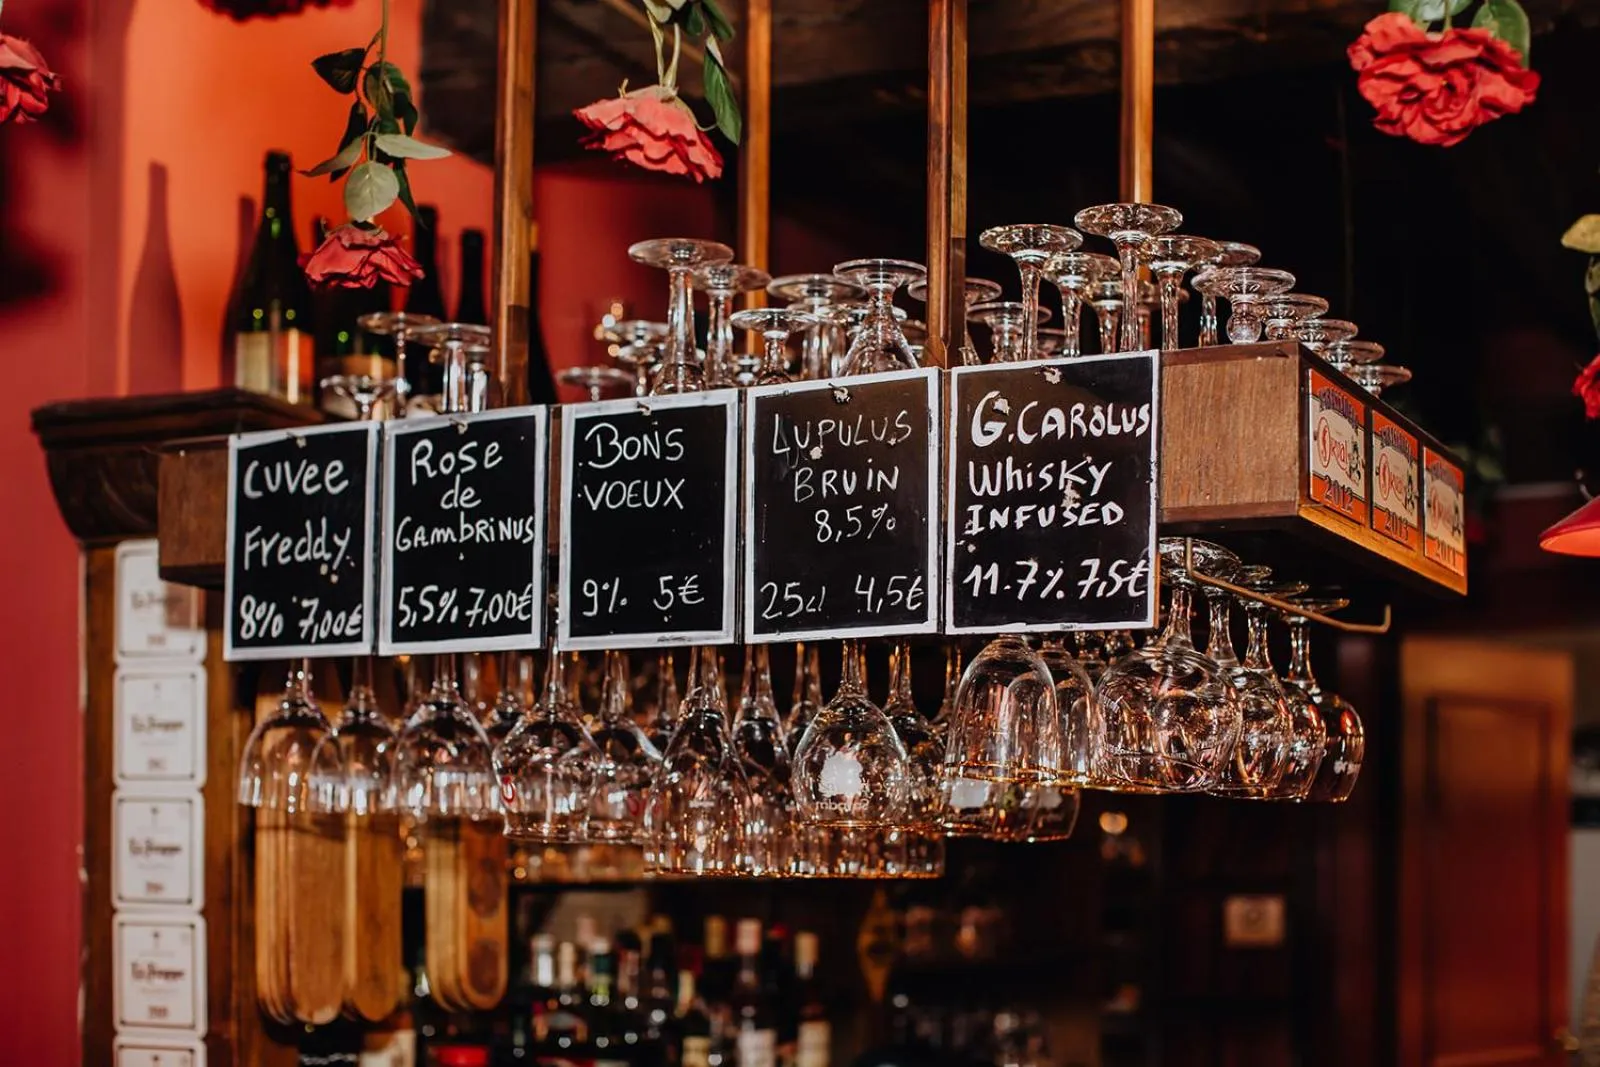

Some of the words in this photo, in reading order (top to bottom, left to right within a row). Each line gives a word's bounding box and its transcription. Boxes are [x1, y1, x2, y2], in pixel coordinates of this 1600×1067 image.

[584, 422, 684, 469] BONS
[772, 410, 912, 455] LUPULUS
[440, 473, 482, 510] de
[583, 478, 685, 511] VOEUX
[814, 503, 897, 543] 8,5%
[964, 501, 1124, 536] INFUSED
[244, 516, 351, 571] Freddy
[398, 585, 459, 628] 5,5%
[464, 583, 533, 628] 7,00€
[582, 576, 628, 617] 9%
[653, 574, 705, 611] 5€
[854, 574, 924, 614] 4,5€
[240, 594, 284, 640] 8%
[298, 598, 363, 643] 7,00€
